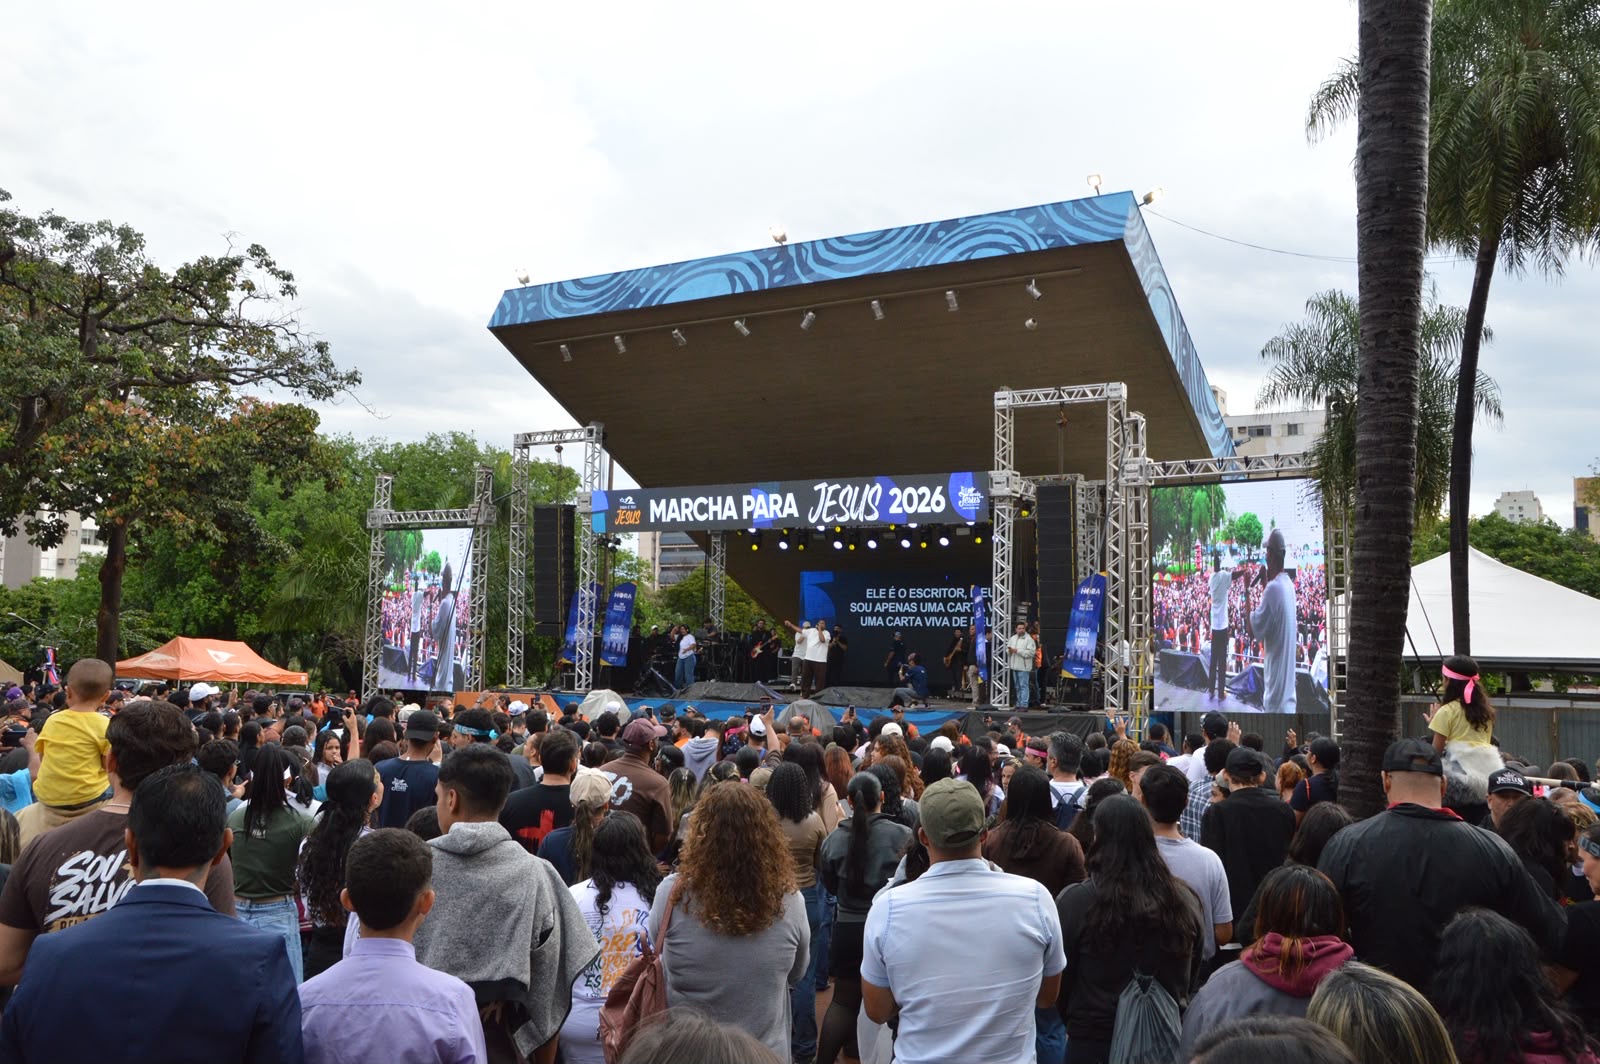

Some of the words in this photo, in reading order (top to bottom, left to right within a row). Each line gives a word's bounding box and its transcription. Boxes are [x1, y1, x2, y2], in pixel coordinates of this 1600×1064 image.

[650, 495, 738, 523] MARCHA
[743, 492, 799, 520] PARA
[808, 482, 883, 523] JESUS
[889, 486, 946, 514] 2026
[614, 509, 641, 525] JESUS
[866, 588, 886, 599] ELE
[889, 585, 896, 599] É
[898, 588, 907, 599] O
[909, 587, 967, 600] ESCRITOR,
[850, 602, 872, 612] SOU
[874, 602, 918, 612] APENAS
[920, 602, 945, 612] UMA
[860, 616, 884, 627] UMA
[885, 616, 922, 627] CARTA
[924, 616, 950, 627] VIVA
[952, 616, 967, 627] DE
[49, 849, 127, 895] SOU
[43, 879, 137, 925] SALV
